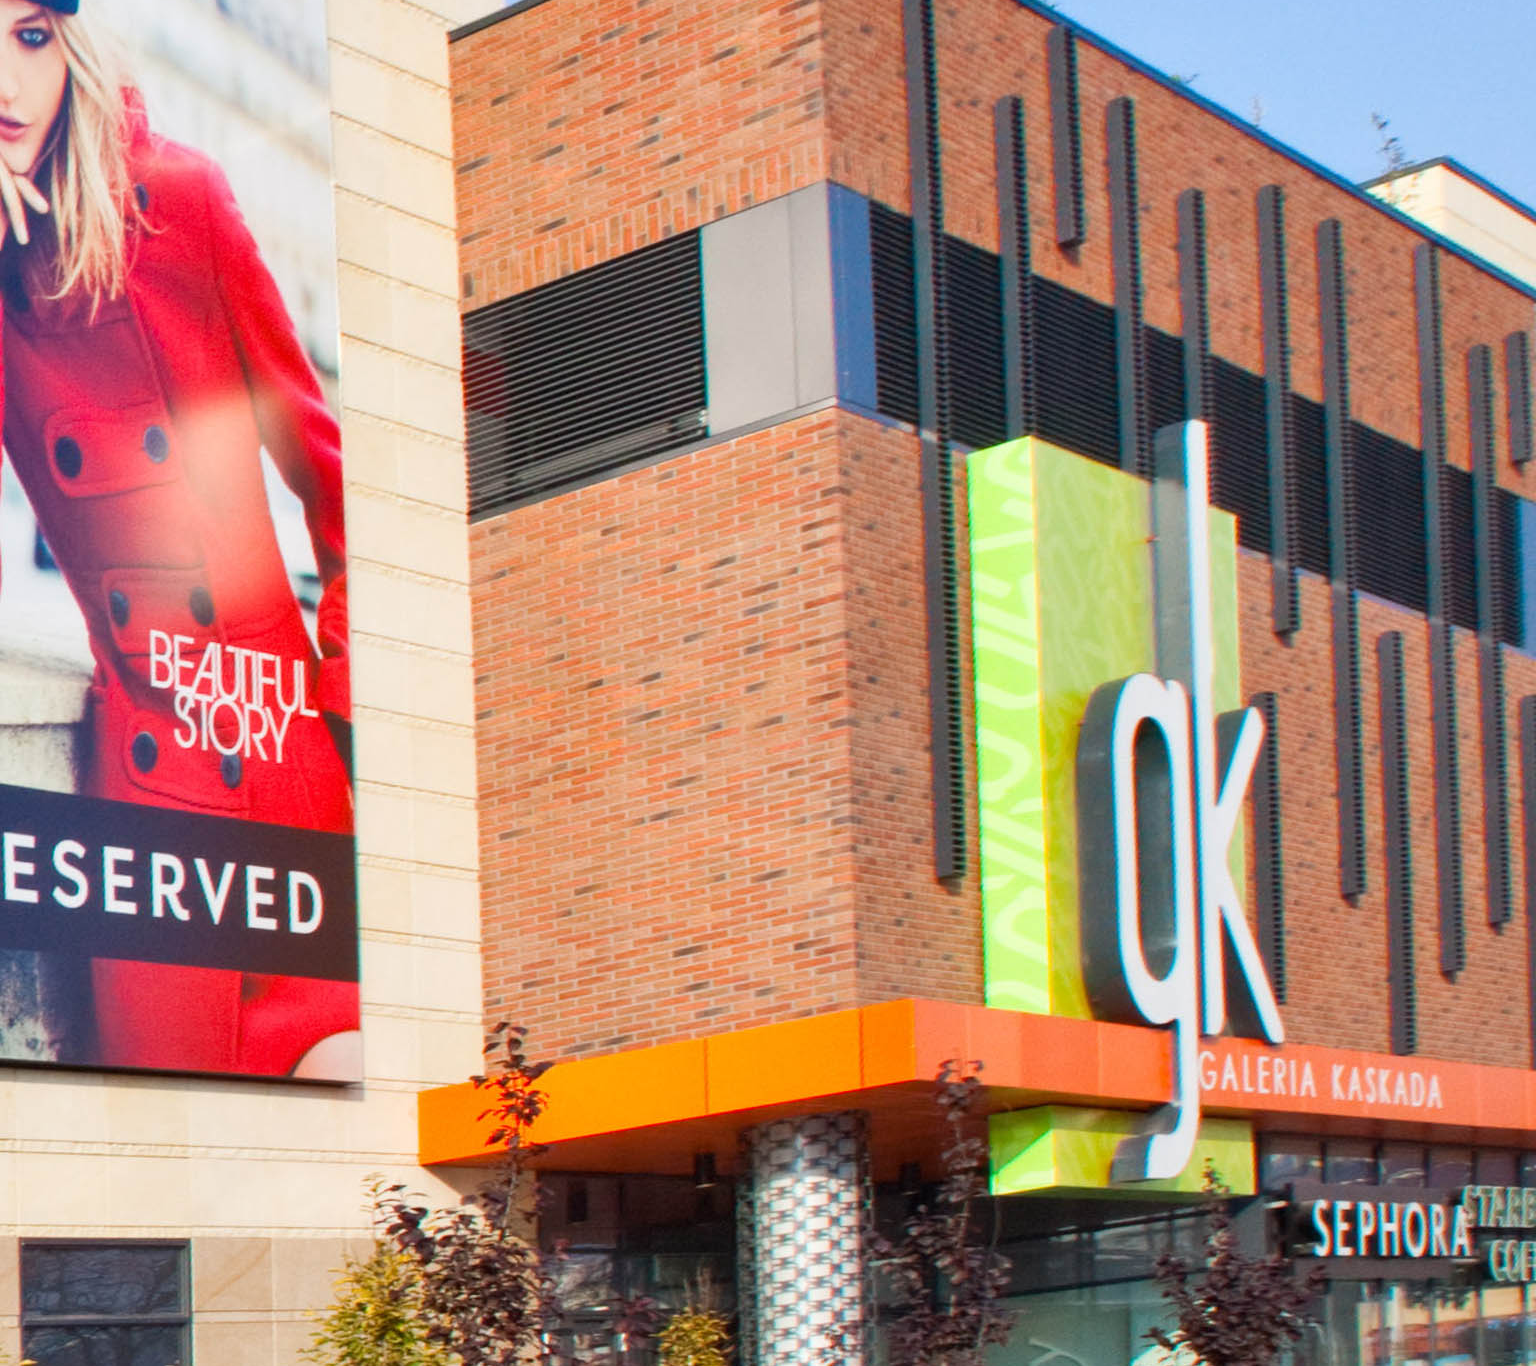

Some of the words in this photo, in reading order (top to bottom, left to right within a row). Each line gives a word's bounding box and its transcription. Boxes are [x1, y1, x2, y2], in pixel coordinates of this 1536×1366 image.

[149, 629, 320, 718] BEAUTIFUL
[173, 688, 292, 764] STORY
[1199, 1050, 1317, 1097] GALERIA
[1332, 1064, 1443, 1109] KASKADA
[1312, 1199, 1471, 1257] SEPHORA
[1488, 1239, 1536, 1282] COF
